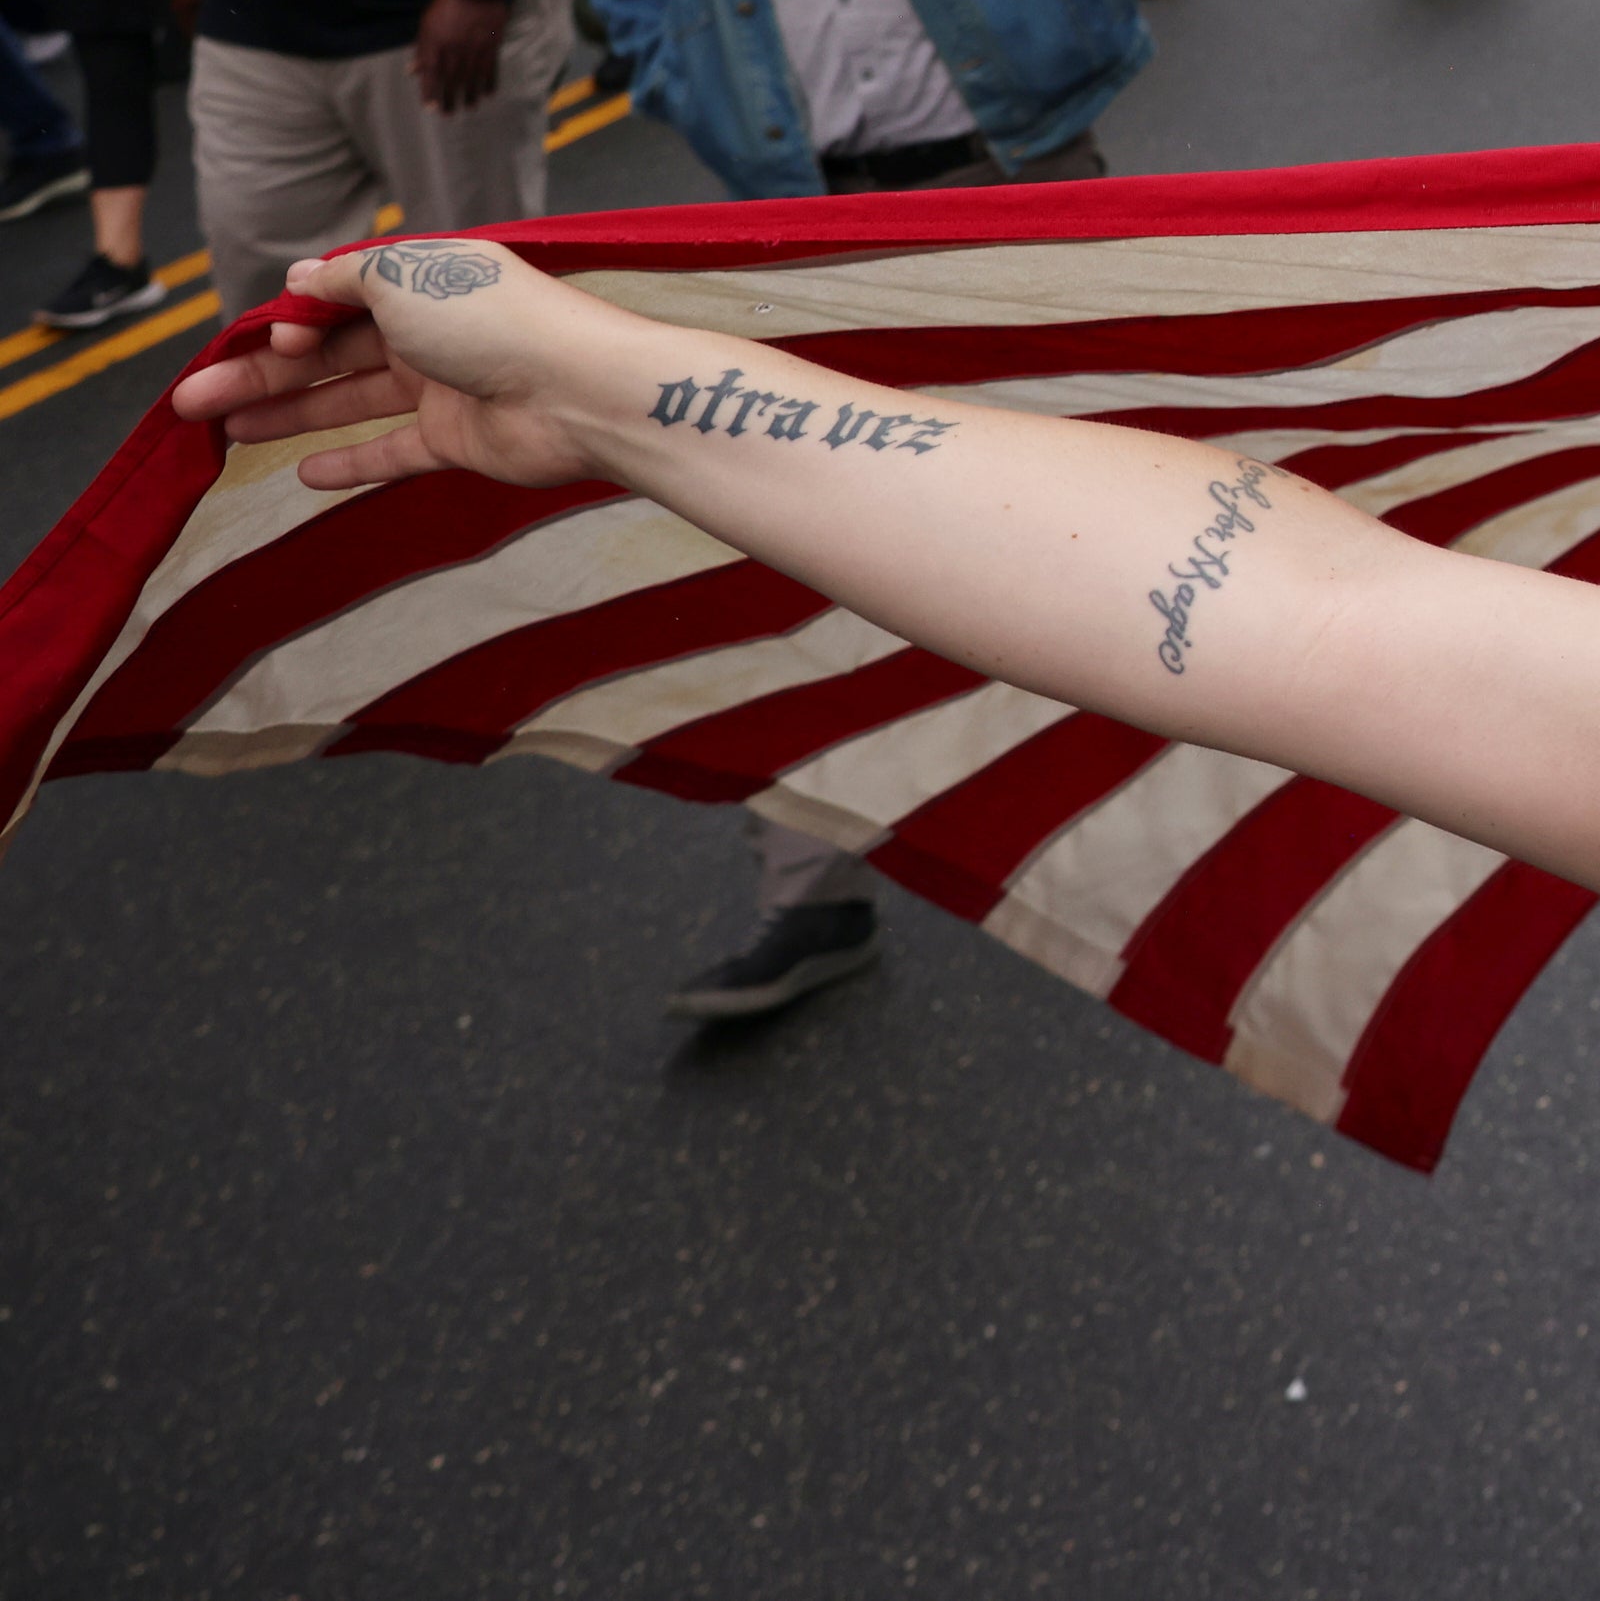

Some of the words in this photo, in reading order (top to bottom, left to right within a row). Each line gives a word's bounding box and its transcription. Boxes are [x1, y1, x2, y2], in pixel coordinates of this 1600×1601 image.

[648, 367, 821, 441] otra
[820, 401, 961, 455] vez
[1206, 480, 1255, 542] for
[1148, 535, 1231, 675] Magic
